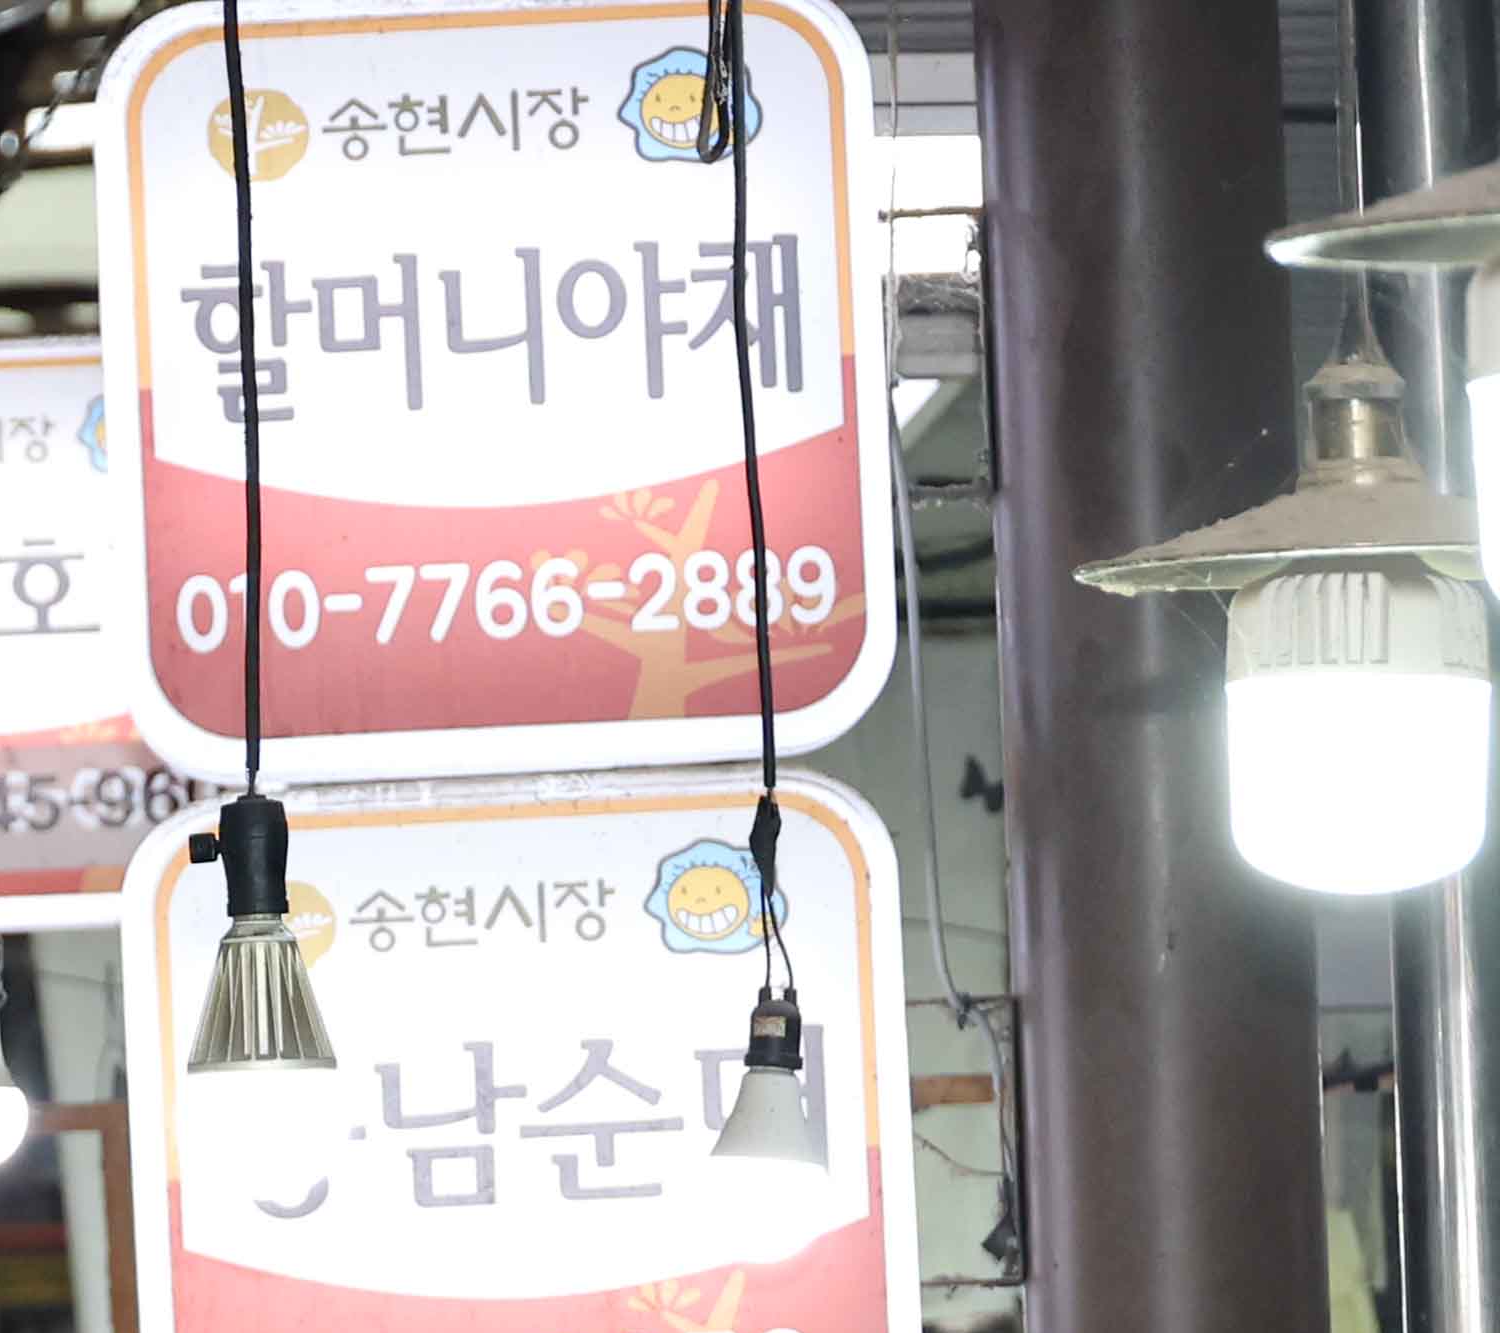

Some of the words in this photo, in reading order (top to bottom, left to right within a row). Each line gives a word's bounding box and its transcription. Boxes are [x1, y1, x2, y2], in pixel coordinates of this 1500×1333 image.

[322, 86, 591, 160] 송현시장
[180, 232, 806, 424] 할머니야채
[348, 879, 617, 953] 송현시장
